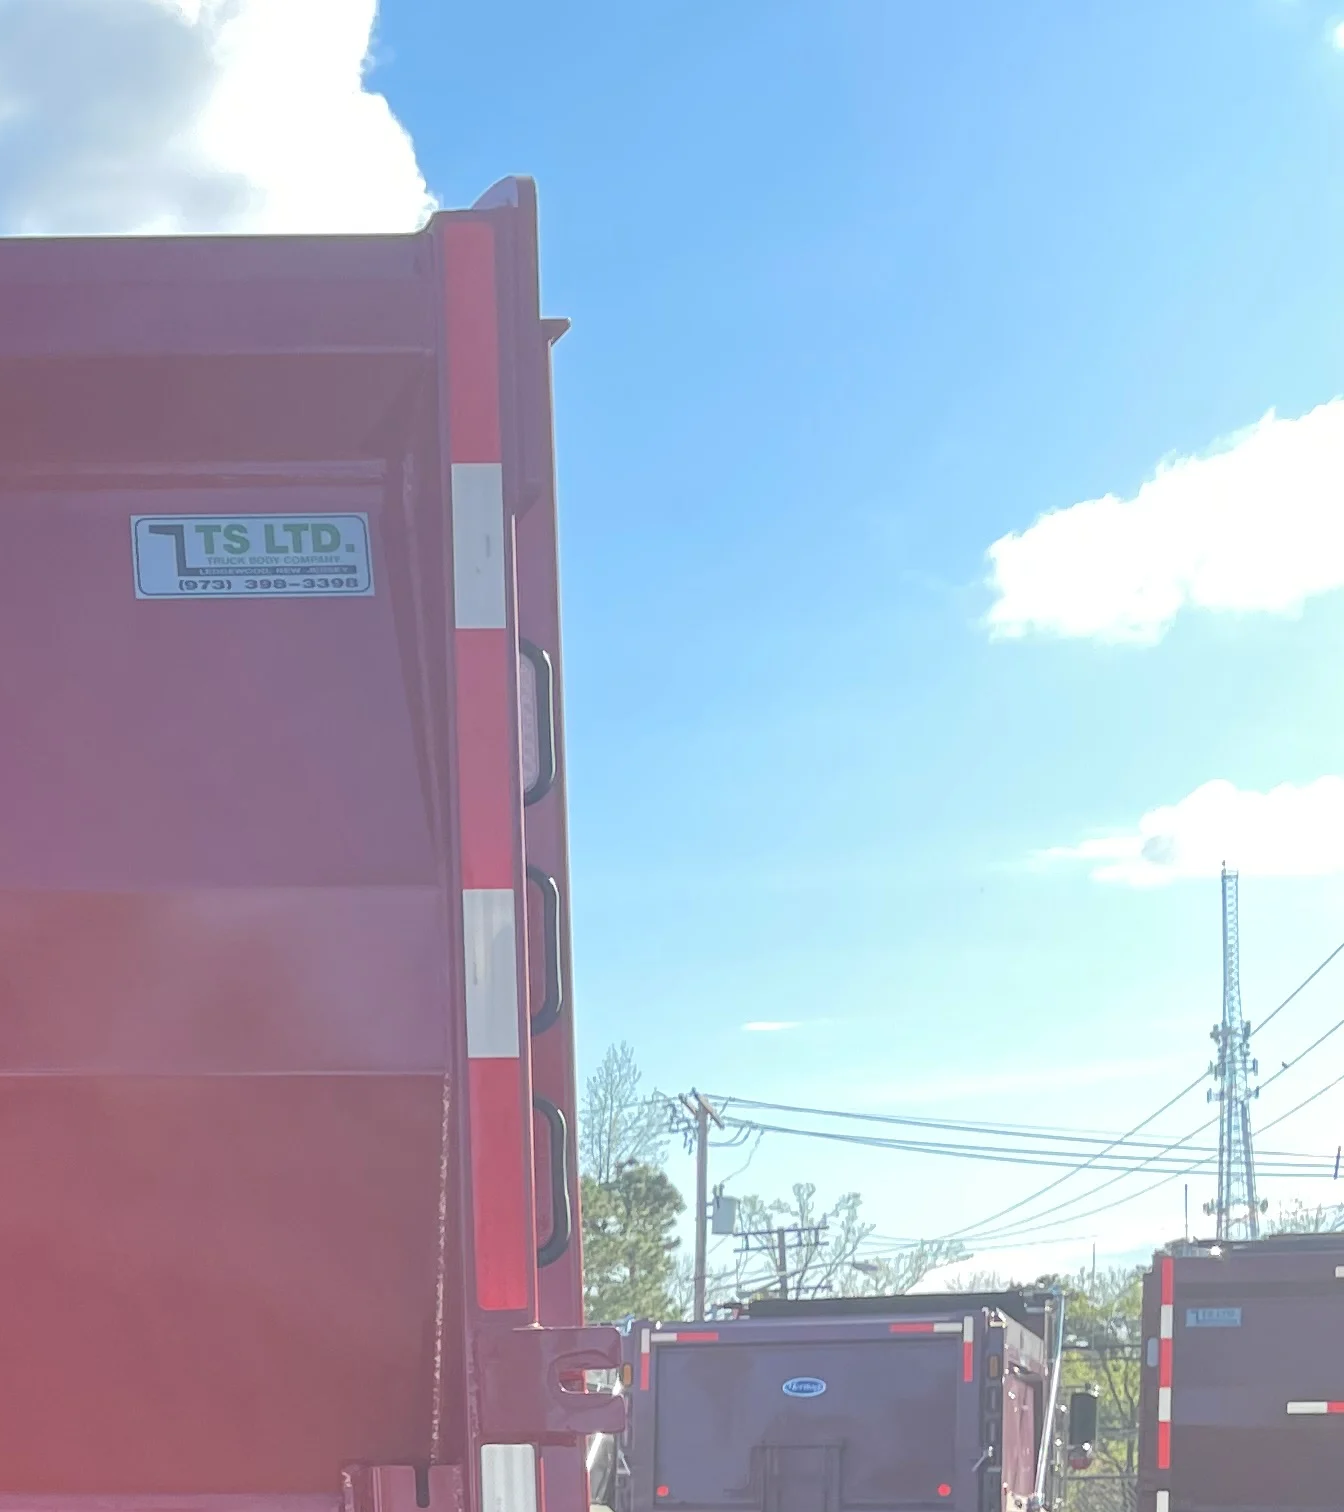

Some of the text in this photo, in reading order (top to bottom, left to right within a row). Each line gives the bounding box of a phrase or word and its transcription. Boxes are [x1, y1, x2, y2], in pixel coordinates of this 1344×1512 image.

[195, 523, 355, 555] TS LTD.
[207, 556, 246, 565] TRUCK
[178, 578, 359, 591] (973) 398-3398
